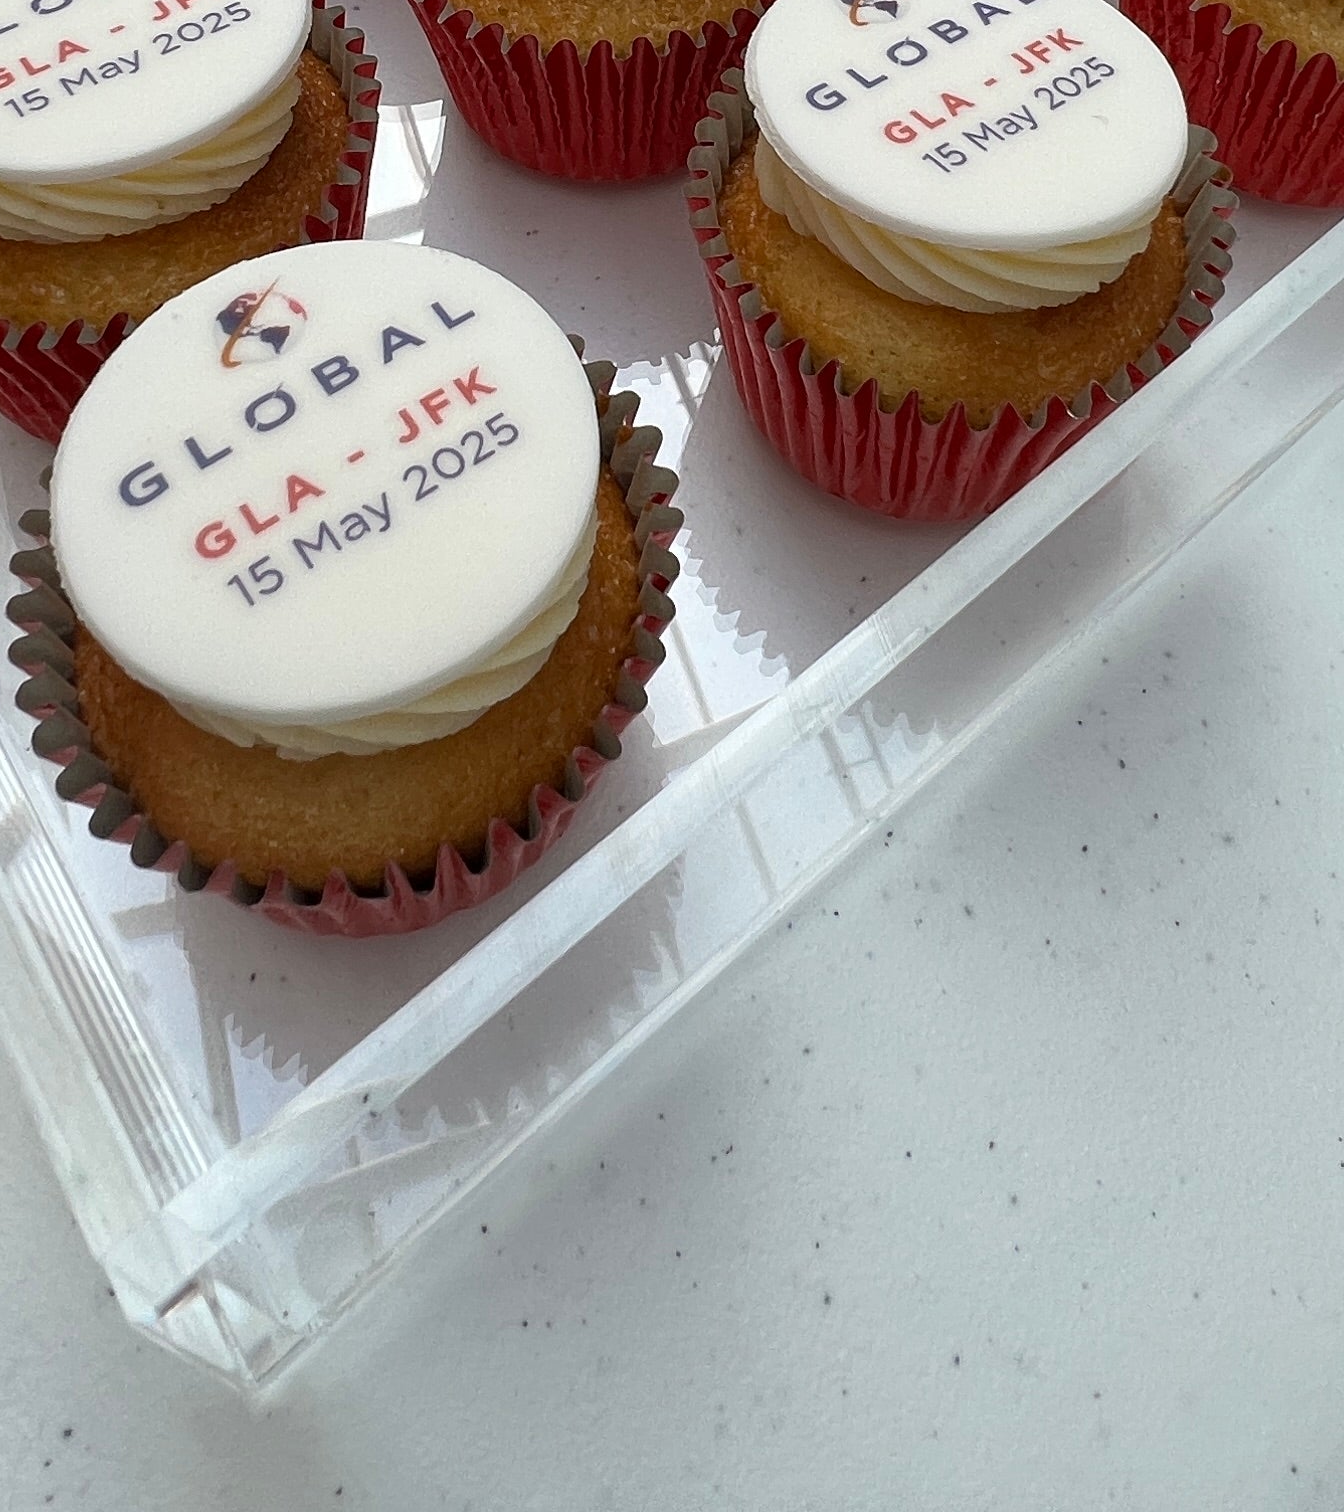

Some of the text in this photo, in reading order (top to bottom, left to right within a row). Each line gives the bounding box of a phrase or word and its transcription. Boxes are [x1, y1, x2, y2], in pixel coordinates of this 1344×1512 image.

[4, 2, 251, 117] 15 May 2025
[109, 25, 126, 34] -
[884, 28, 1084, 144] GLA - JFK
[922, 57, 1115, 173] 15 May 2025
[118, 302, 475, 507] GLOBAL
[194, 366, 497, 560] GLA - JFK
[227, 412, 519, 606] 15 May 2025
